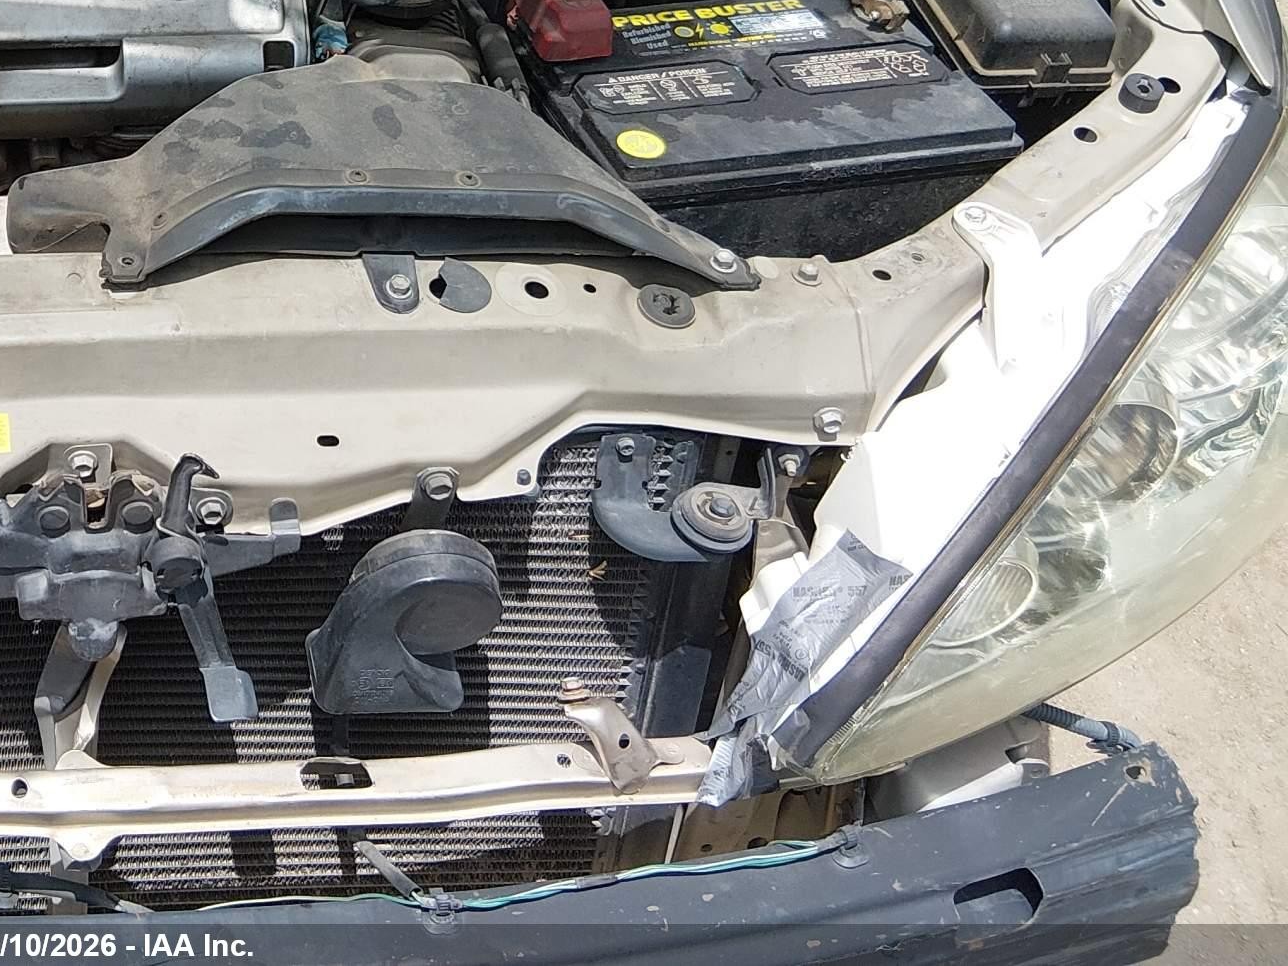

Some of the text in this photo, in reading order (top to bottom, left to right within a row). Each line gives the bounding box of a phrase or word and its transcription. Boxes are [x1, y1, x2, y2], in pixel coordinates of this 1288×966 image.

[612, 0, 806, 28] PRICE BUSTER
[646, 39, 669, 49] Used
[618, 73, 659, 83] DANGER
[669, 68, 707, 77] POISON
